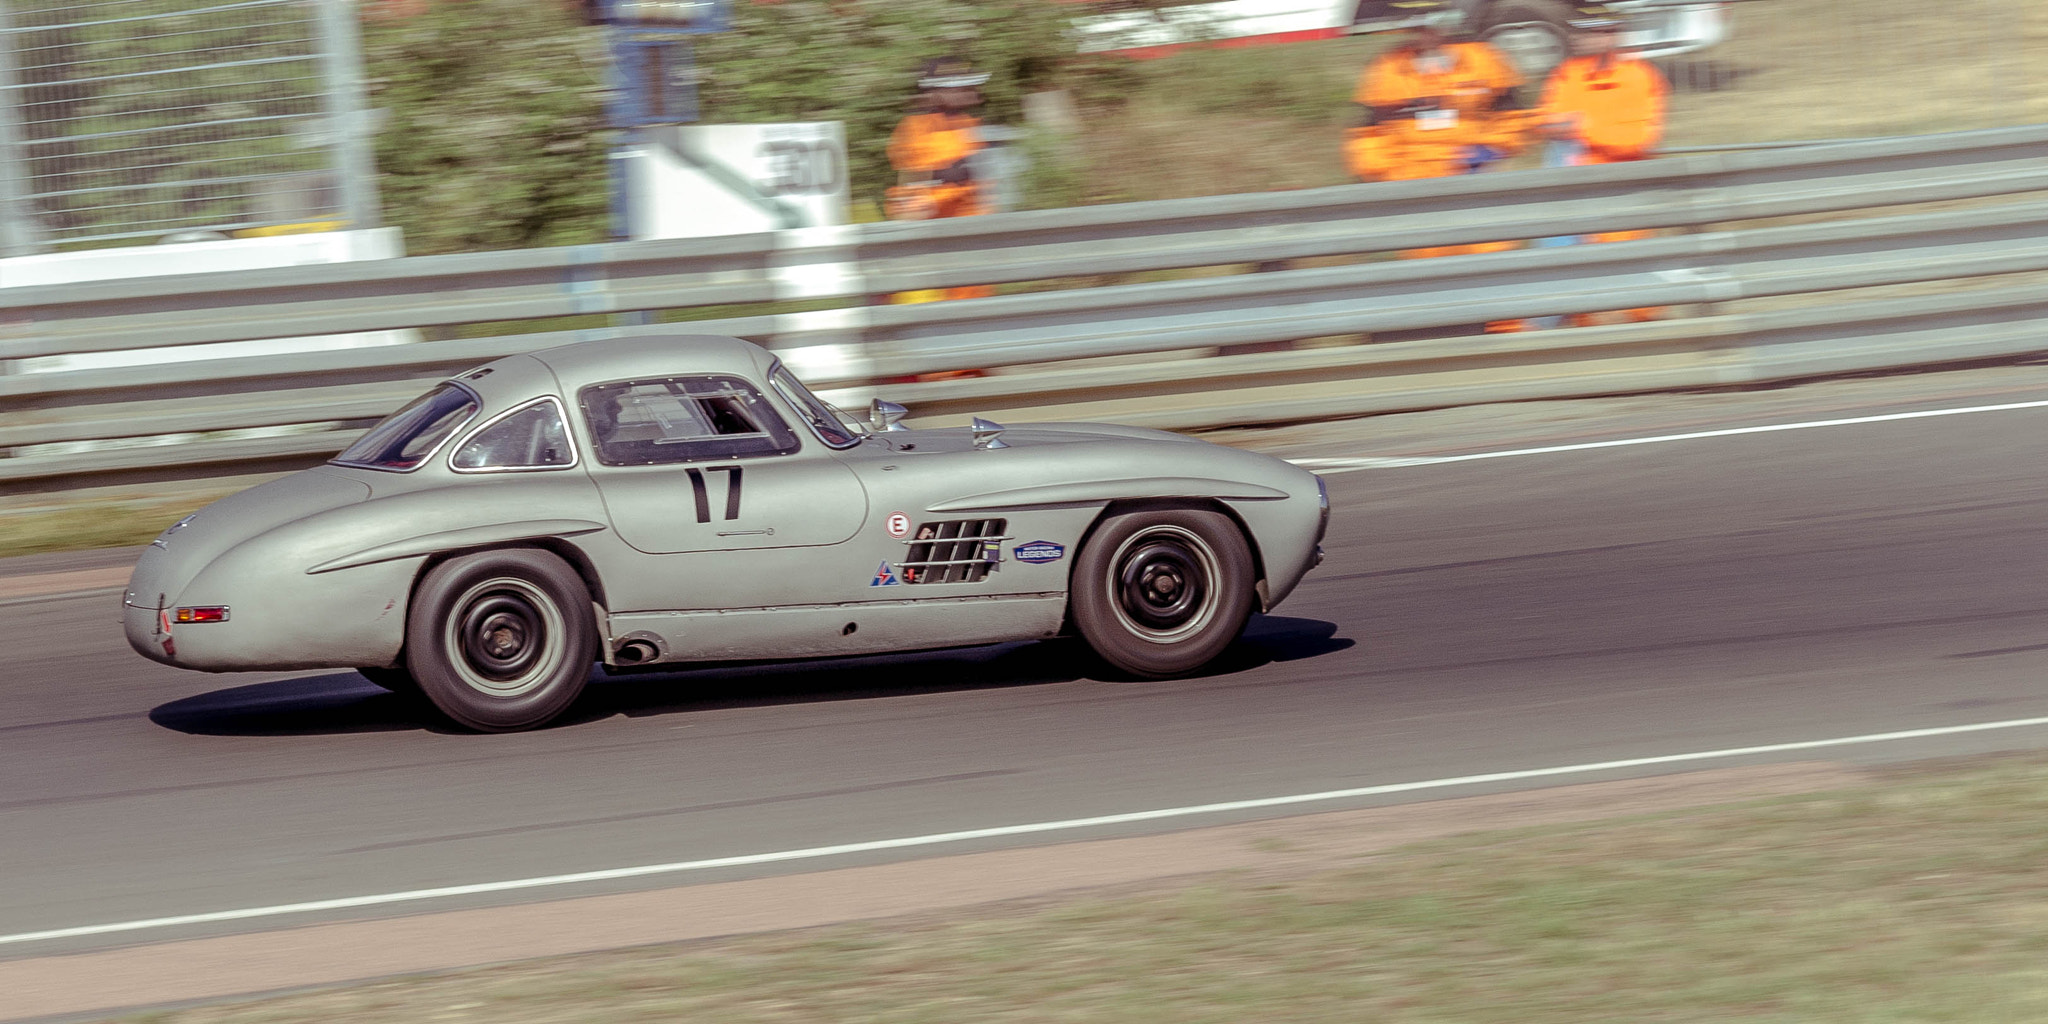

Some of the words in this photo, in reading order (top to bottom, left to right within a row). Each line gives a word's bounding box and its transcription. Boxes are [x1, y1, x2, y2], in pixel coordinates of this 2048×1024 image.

[684, 465, 744, 524] 17
[893, 517, 904, 533] E
[1016, 549, 1062, 559] LEGENDS
